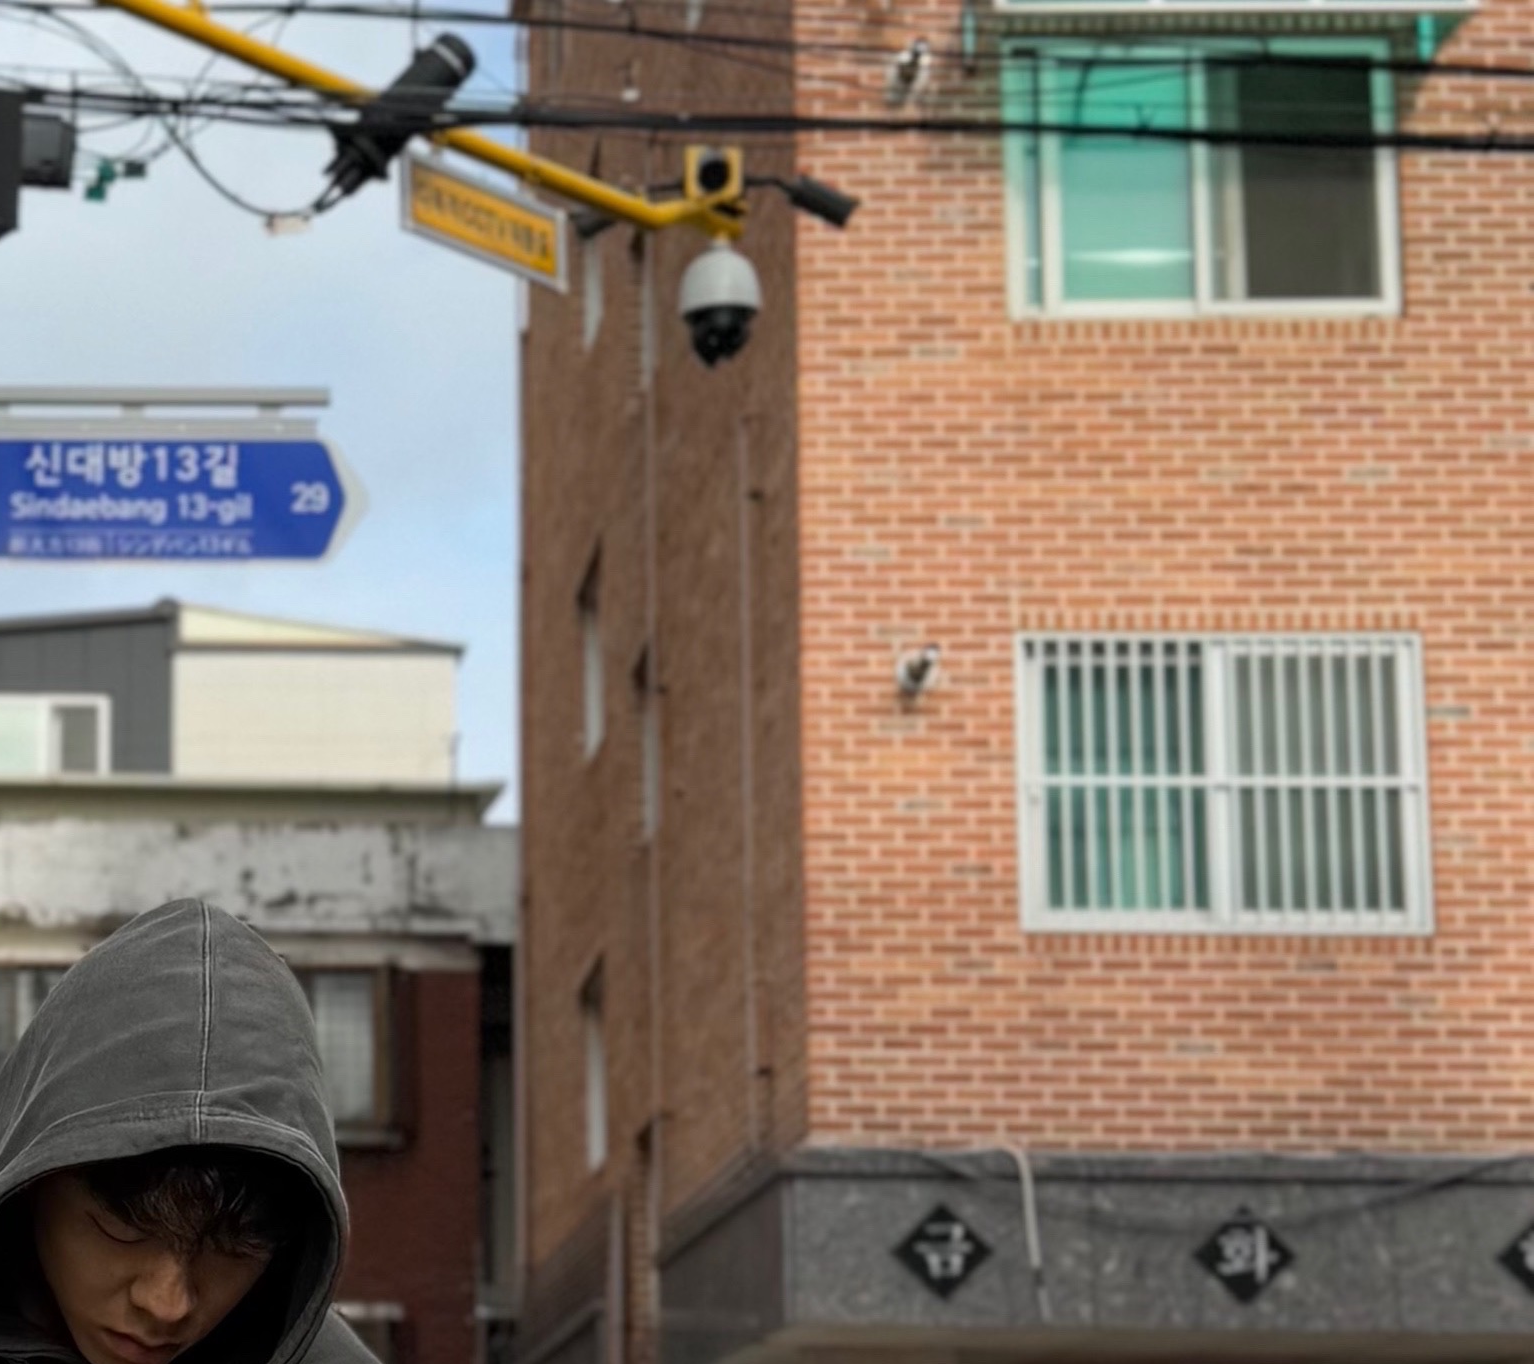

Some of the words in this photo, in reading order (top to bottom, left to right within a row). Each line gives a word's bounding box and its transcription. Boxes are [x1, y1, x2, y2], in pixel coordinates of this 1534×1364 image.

[24, 442, 240, 488] 신대방13길
[10, 491, 167, 526] Sindaebang
[177, 493, 254, 526] 13-gil
[290, 482, 331, 515] 29
[1216, 1223, 1282, 1284] 화
